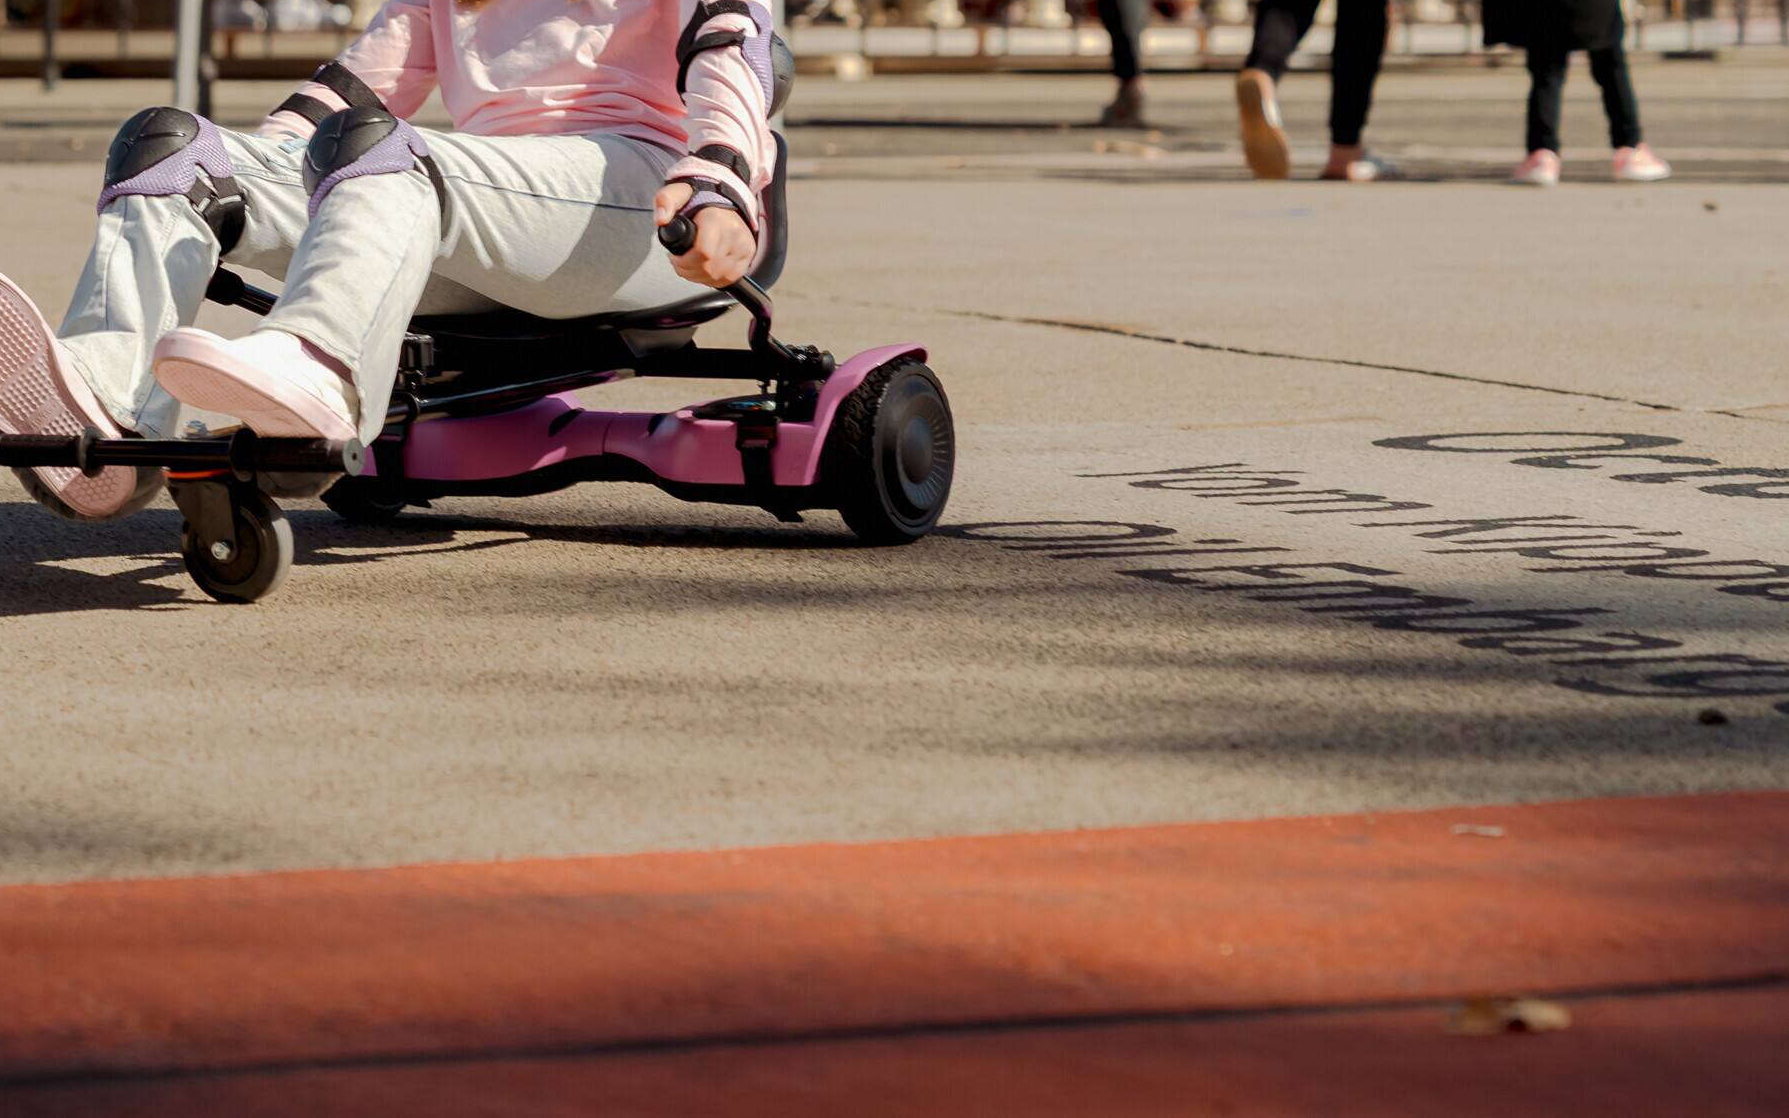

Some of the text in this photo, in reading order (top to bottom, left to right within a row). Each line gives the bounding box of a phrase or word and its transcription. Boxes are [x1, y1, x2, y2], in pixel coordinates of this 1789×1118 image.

[1073, 463, 1434, 514] Yom
[926, 520, 1789, 716] Oil Embarg
